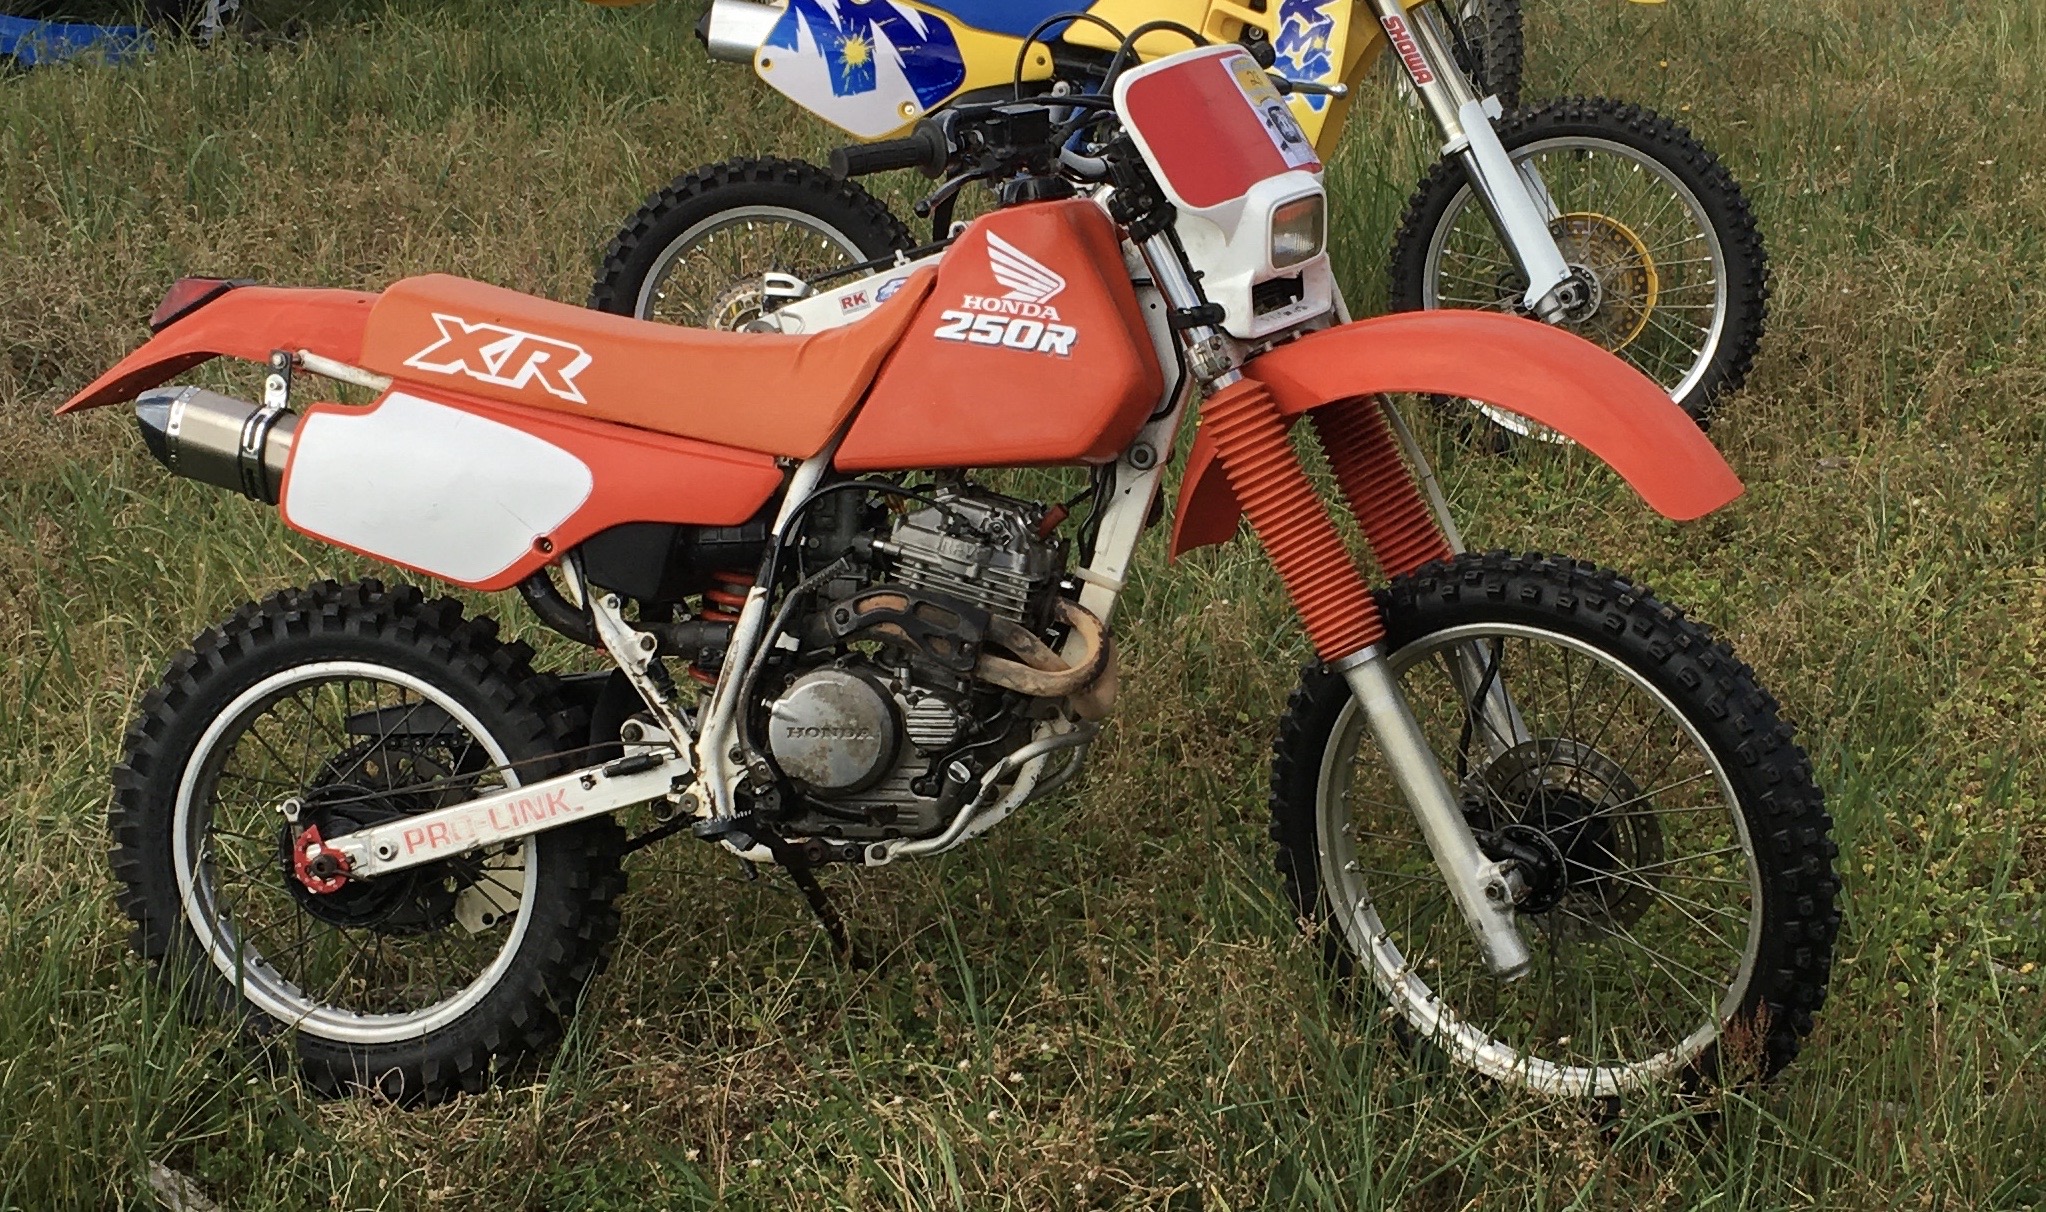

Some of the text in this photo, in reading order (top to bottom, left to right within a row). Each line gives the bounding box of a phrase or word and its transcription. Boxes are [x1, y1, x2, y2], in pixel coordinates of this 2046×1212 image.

[1382, 15, 1434, 85] SHOWA
[841, 292, 867, 310] RK
[961, 295, 1060, 321] HONDA
[933, 309, 1077, 357] 250R
[403, 312, 592, 404] XR
[786, 726, 875, 740] HONDA
